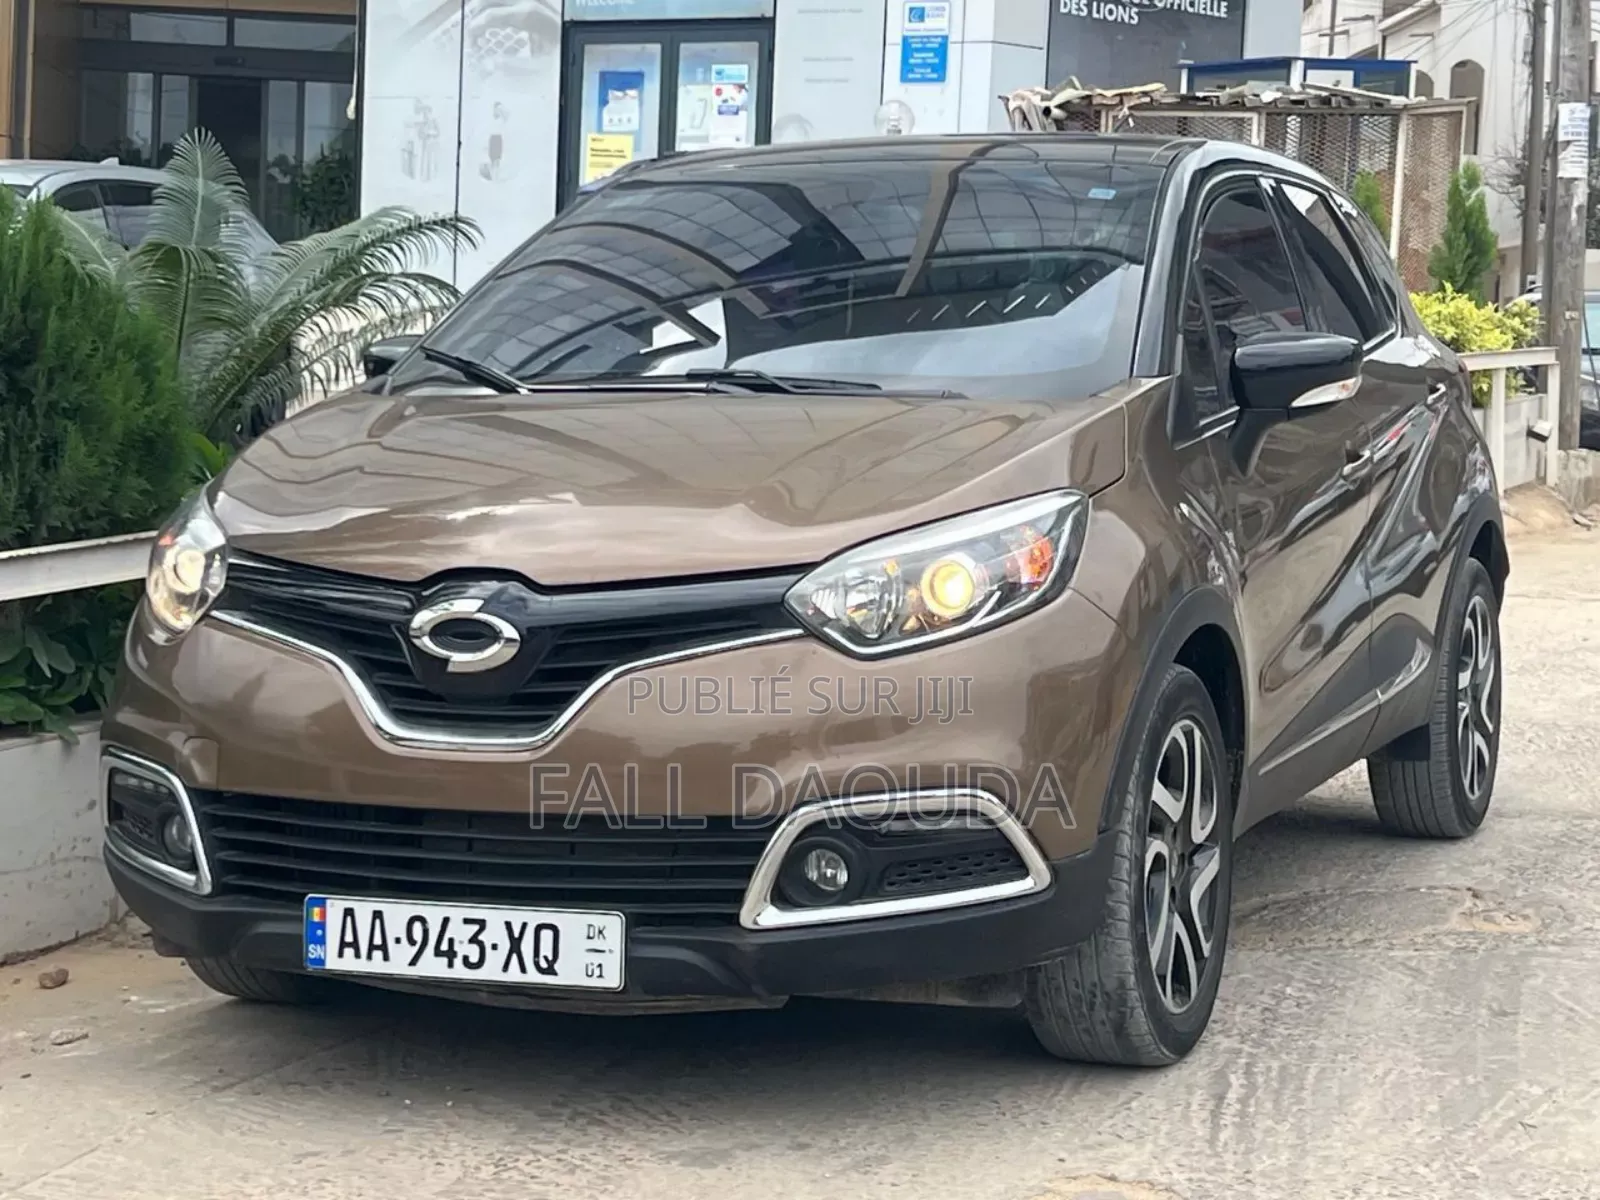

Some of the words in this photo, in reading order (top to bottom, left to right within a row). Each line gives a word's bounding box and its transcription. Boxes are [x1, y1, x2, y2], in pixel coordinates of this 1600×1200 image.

[1060, 0, 1088, 17] DES
[1092, 1, 1139, 25] LIONS
[586, 923, 606, 941] DK
[308, 943, 325, 960] SN
